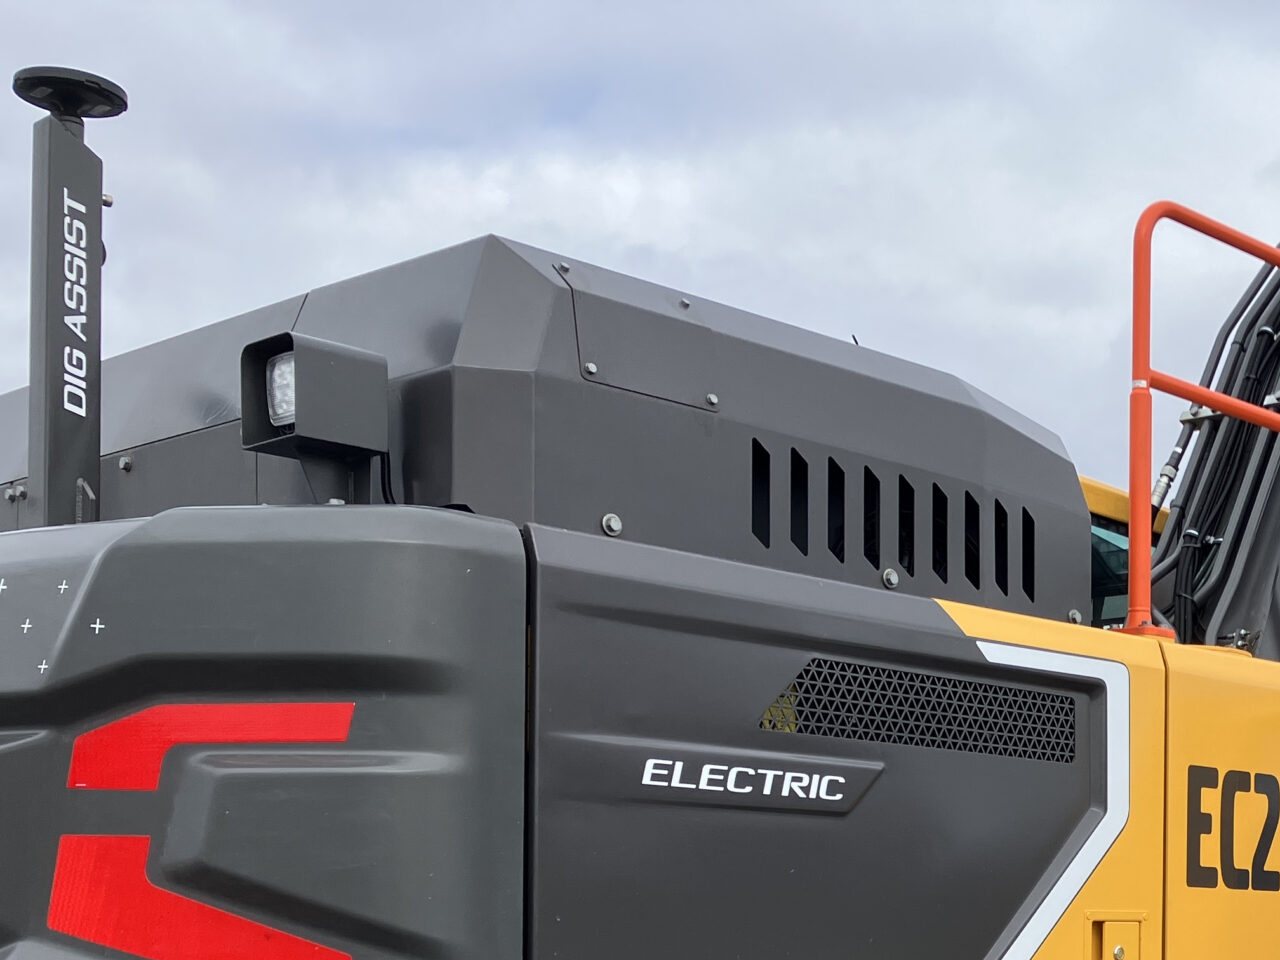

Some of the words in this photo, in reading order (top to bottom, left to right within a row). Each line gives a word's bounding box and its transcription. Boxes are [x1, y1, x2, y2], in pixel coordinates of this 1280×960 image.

[63, 187, 88, 342] ASSIST
[63, 345, 87, 418] DIG
[641, 758, 846, 801] ELECTRIC
